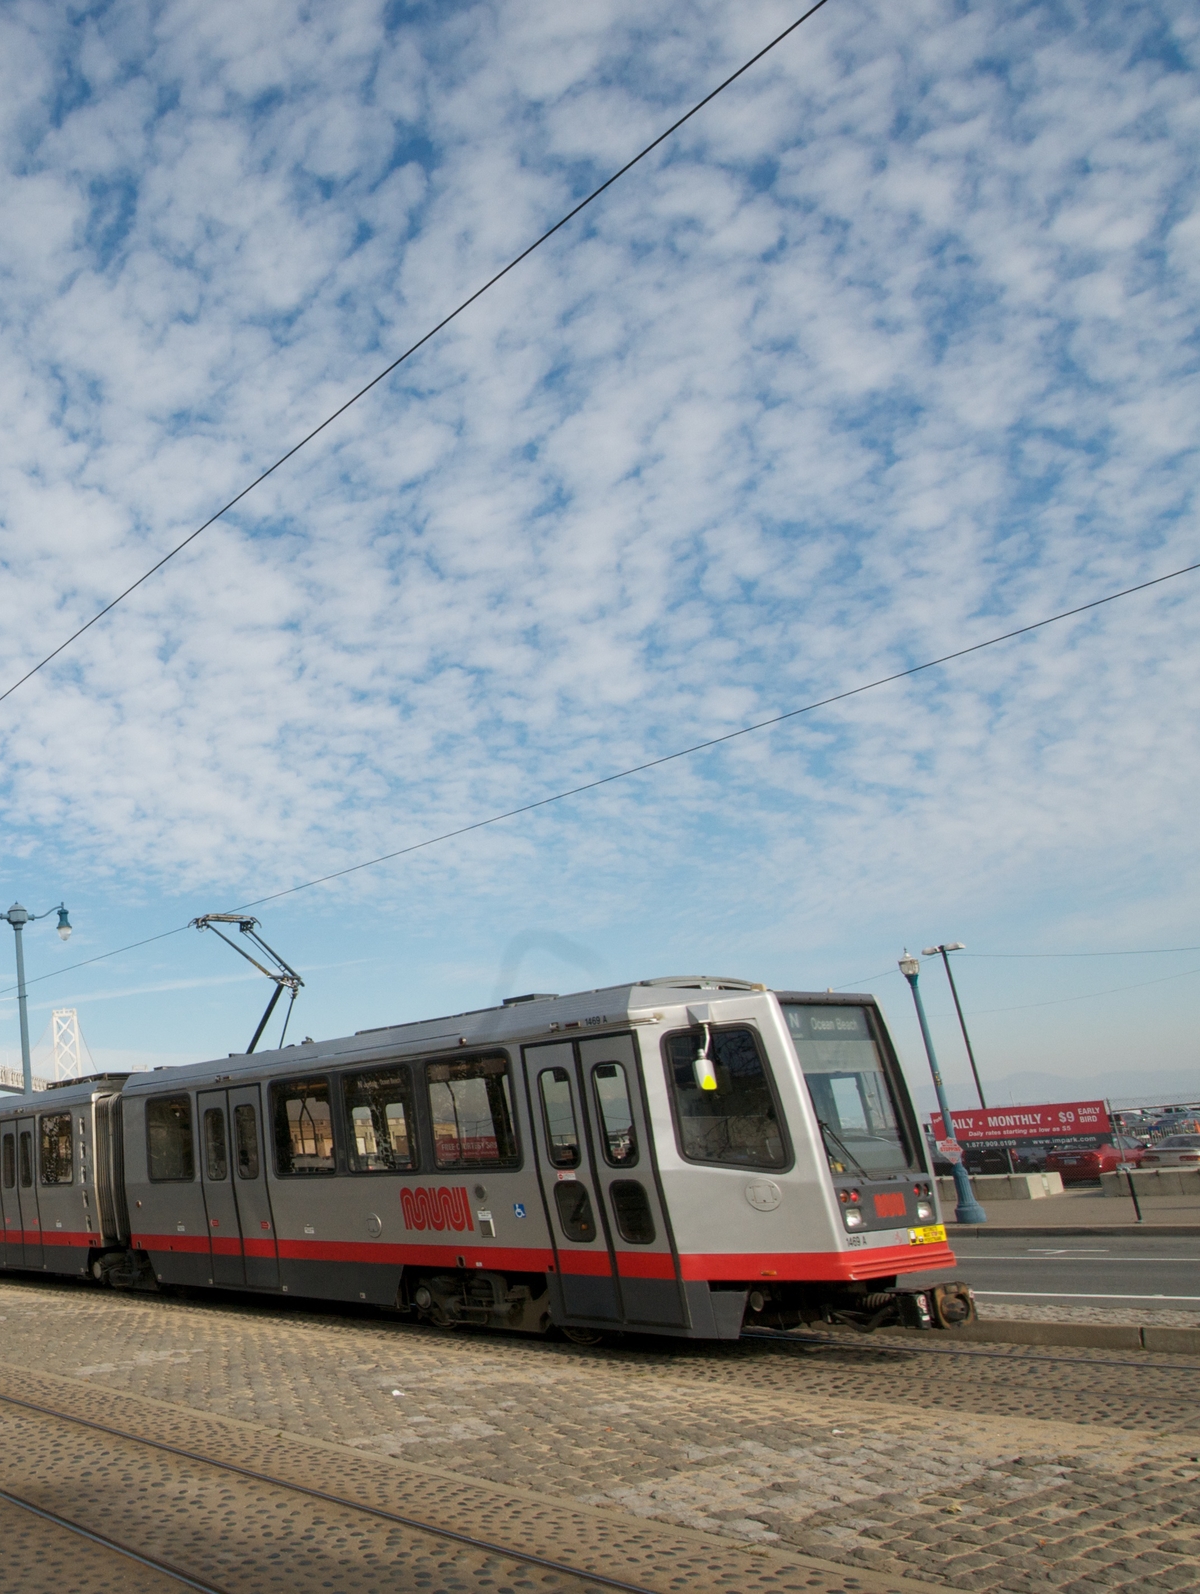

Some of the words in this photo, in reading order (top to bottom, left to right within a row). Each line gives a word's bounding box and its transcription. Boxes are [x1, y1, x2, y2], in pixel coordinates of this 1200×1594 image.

[585, 1016, 600, 1026] 1469
[602, 1015, 608, 1023] A
[788, 1012, 800, 1028] N
[810, 1017, 835, 1030] Ocean
[836, 1017, 858, 1030] Beach
[1077, 1107, 1100, 1115] EARLY
[952, 1117, 974, 1129] AILY
[987, 1113, 1042, 1127] MONTHLY
[1058, 1111, 1075, 1124] $9
[1079, 1115, 1098, 1123] BIRD
[1003, 1128, 1028, 1136] starting
[1032, 1135, 1097, 1145] www.impark.com
[441, 1143, 455, 1151] FREE
[846, 1236, 861, 1247] 1469
[862, 1236, 867, 1245] A
